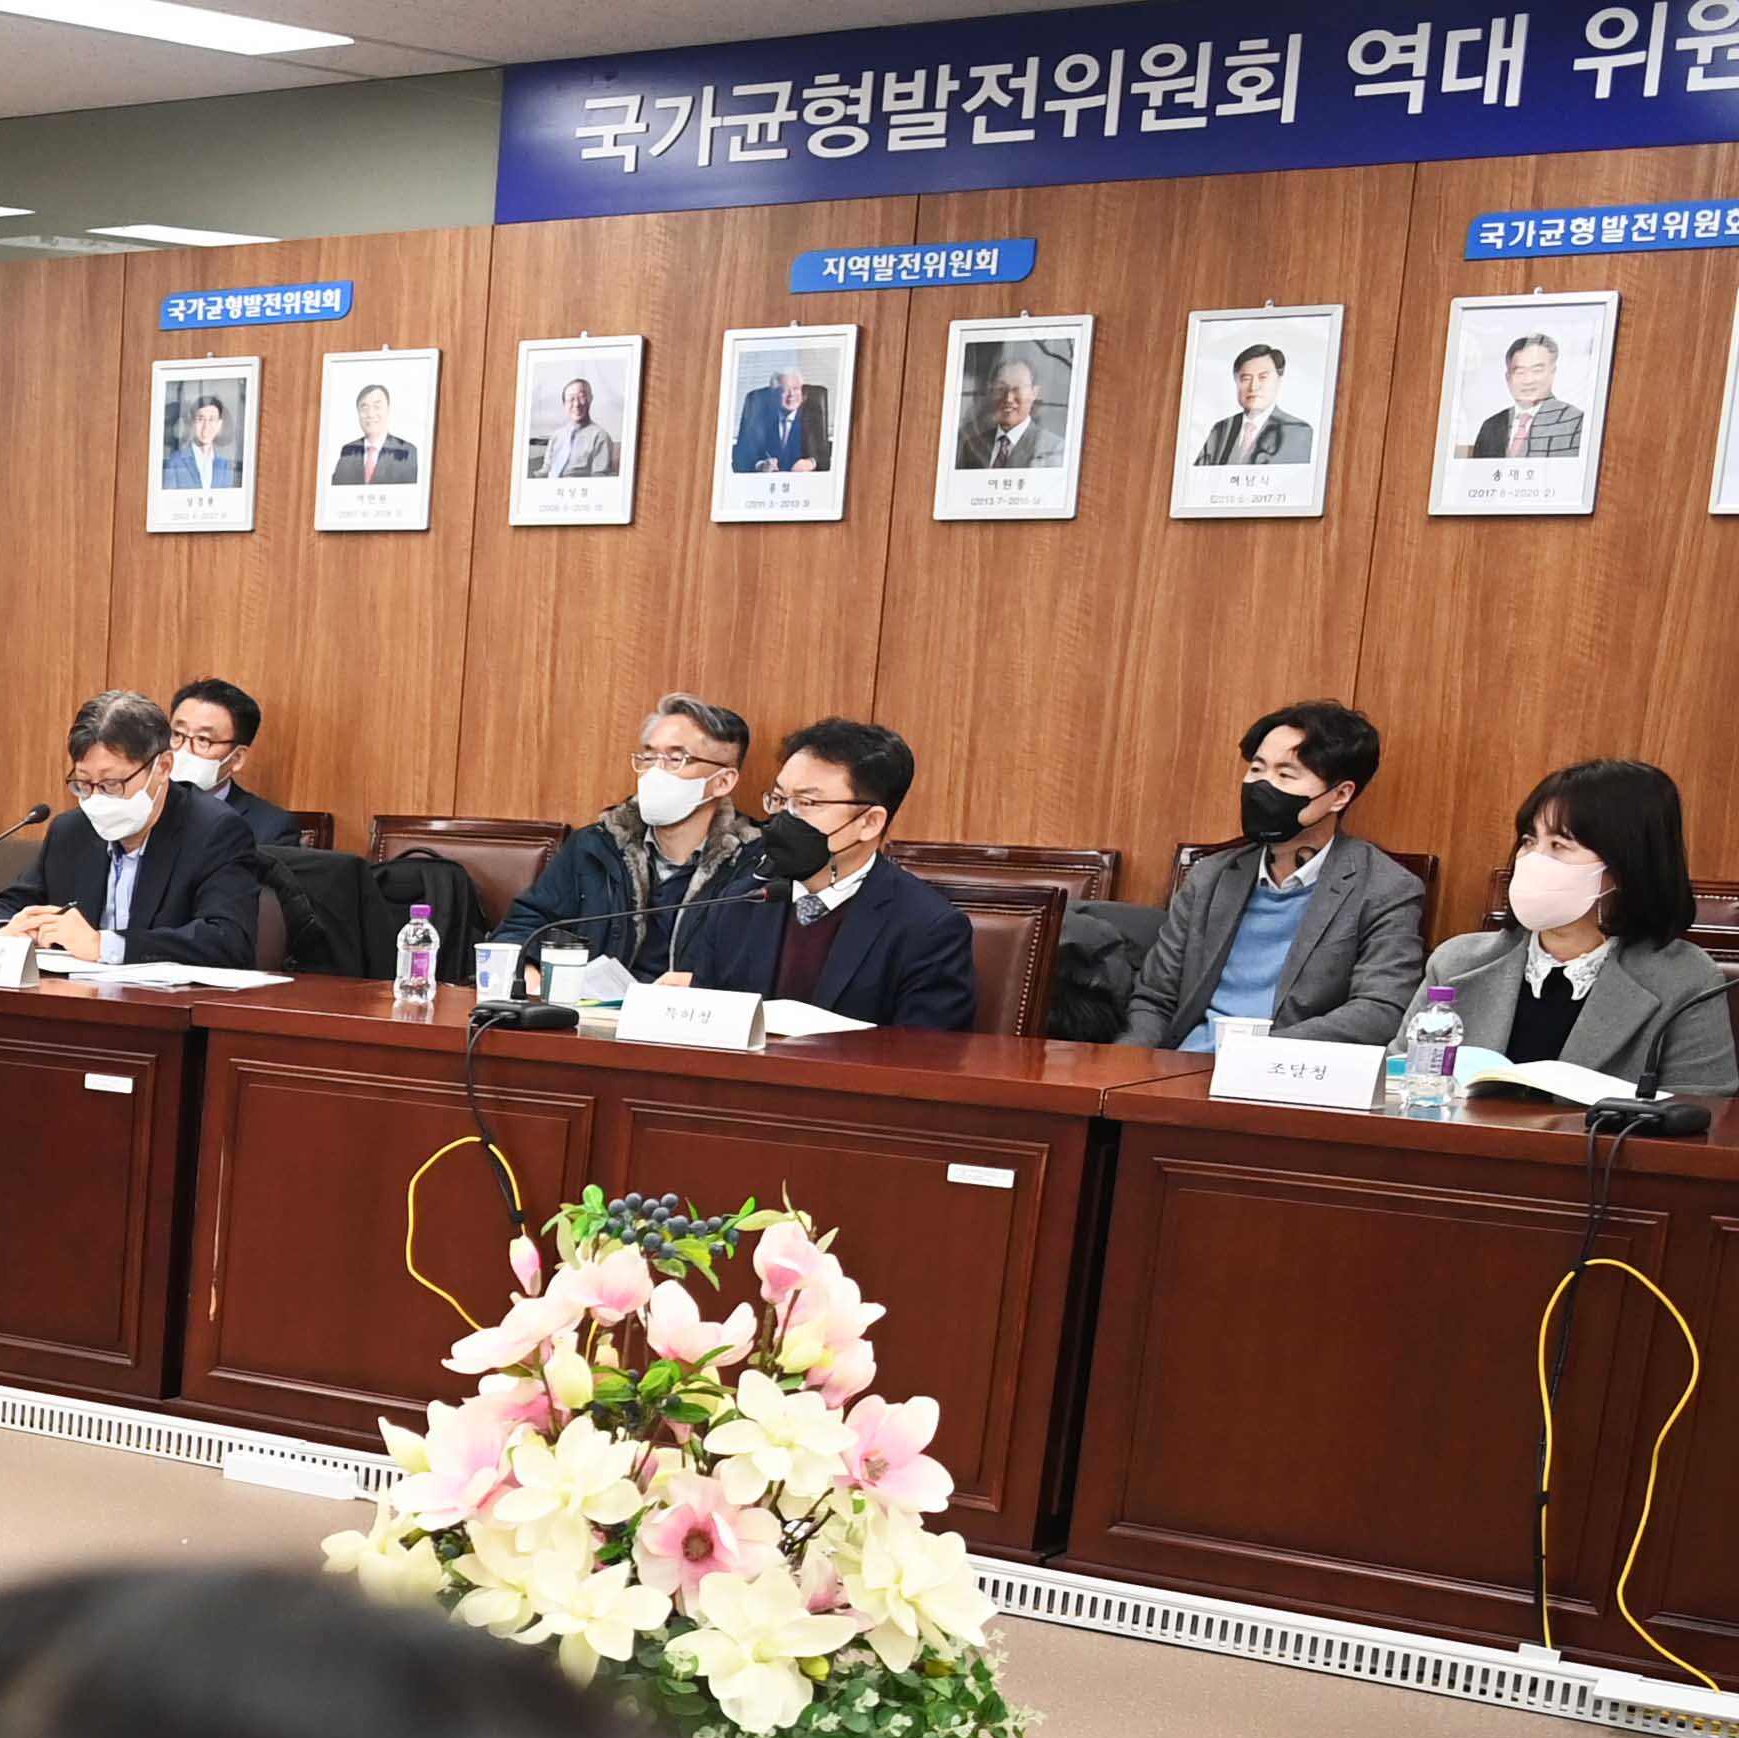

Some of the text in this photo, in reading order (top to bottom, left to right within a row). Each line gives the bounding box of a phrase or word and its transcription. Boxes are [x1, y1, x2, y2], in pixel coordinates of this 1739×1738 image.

[573, 31, 1302, 173] 국가균형발전위원회
[1348, 12, 1528, 116] 역대
[822, 247, 1000, 284] 지역발전위원회
[166, 287, 342, 323] 국가균형발전위원회
[1266, 1061, 1327, 1081] 조달청
